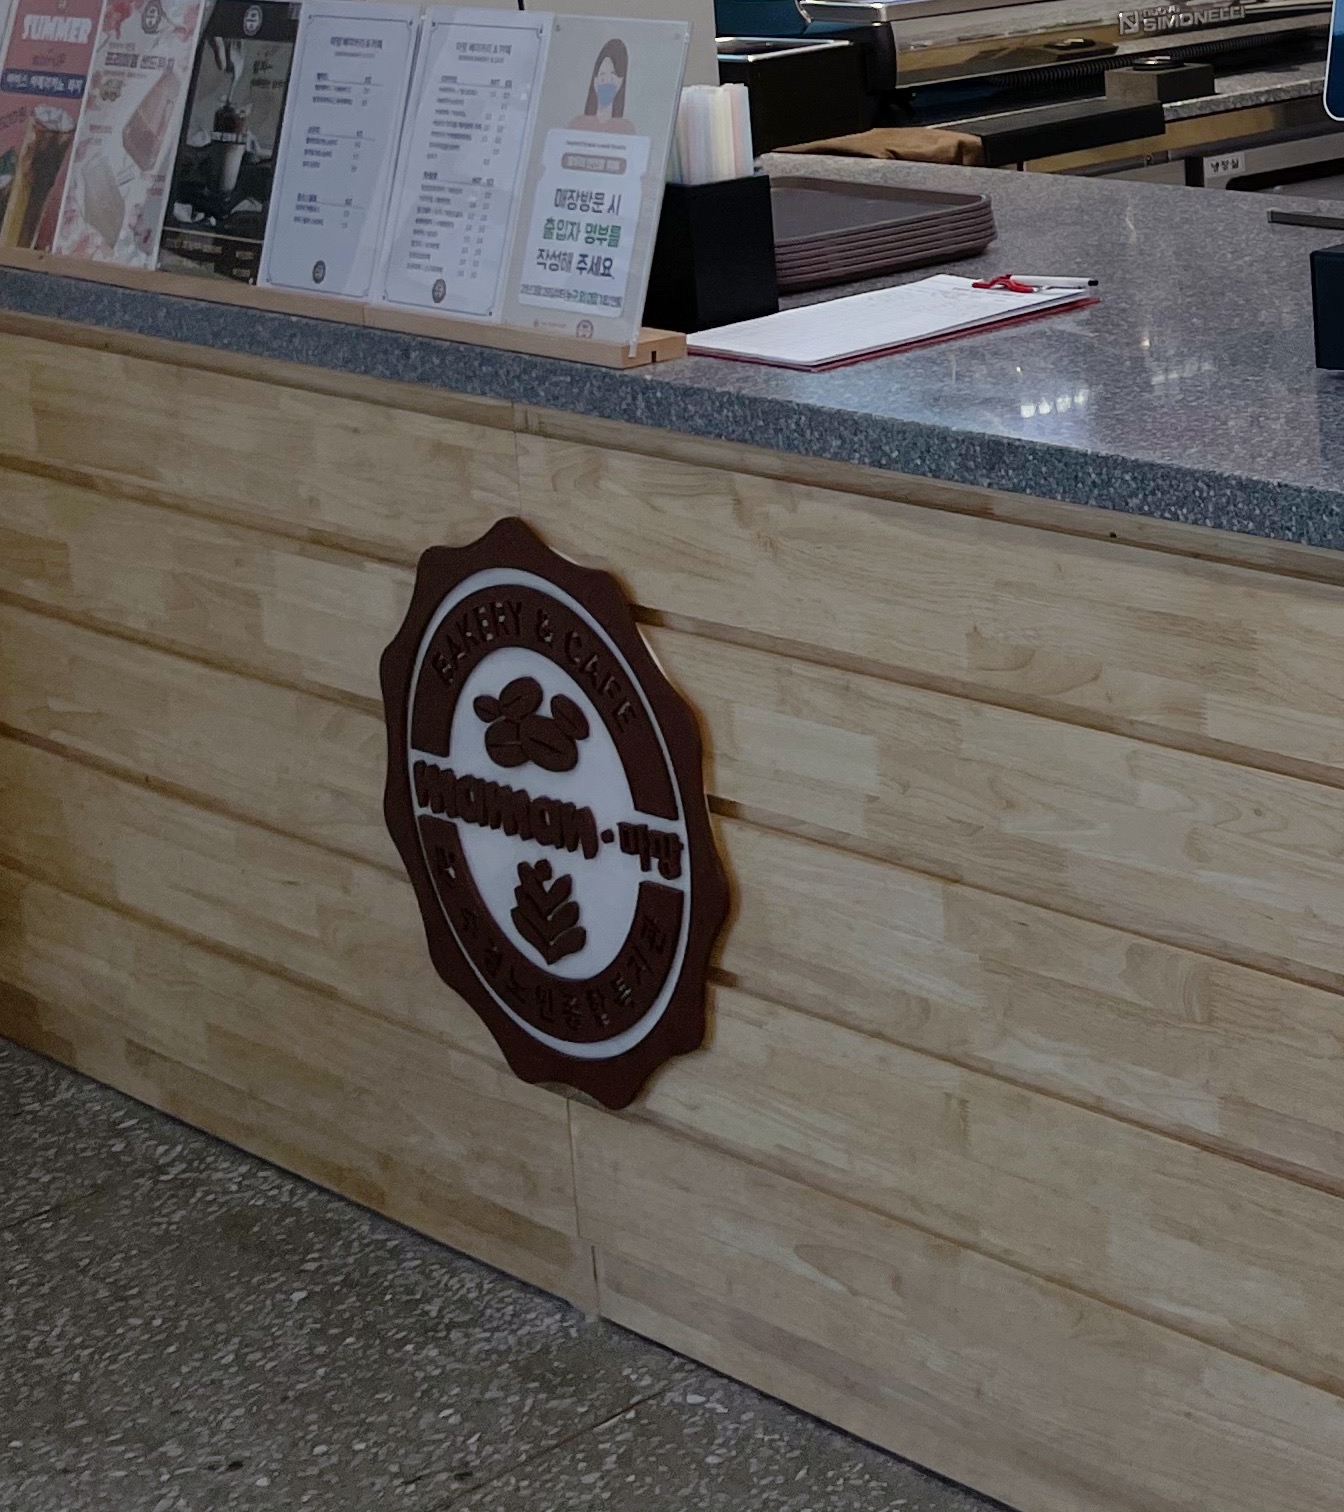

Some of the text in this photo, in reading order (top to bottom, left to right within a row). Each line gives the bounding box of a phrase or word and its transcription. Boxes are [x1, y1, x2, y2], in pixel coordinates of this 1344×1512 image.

[22, 14, 93, 44] SUMMER
[554, 188, 622, 217] 매장방문 시
[543, 217, 622, 248] 출입자 명부를
[536, 248, 573, 273] 작성해
[432, 601, 525, 687] BAKERY
[565, 629, 639, 734] CAFE
